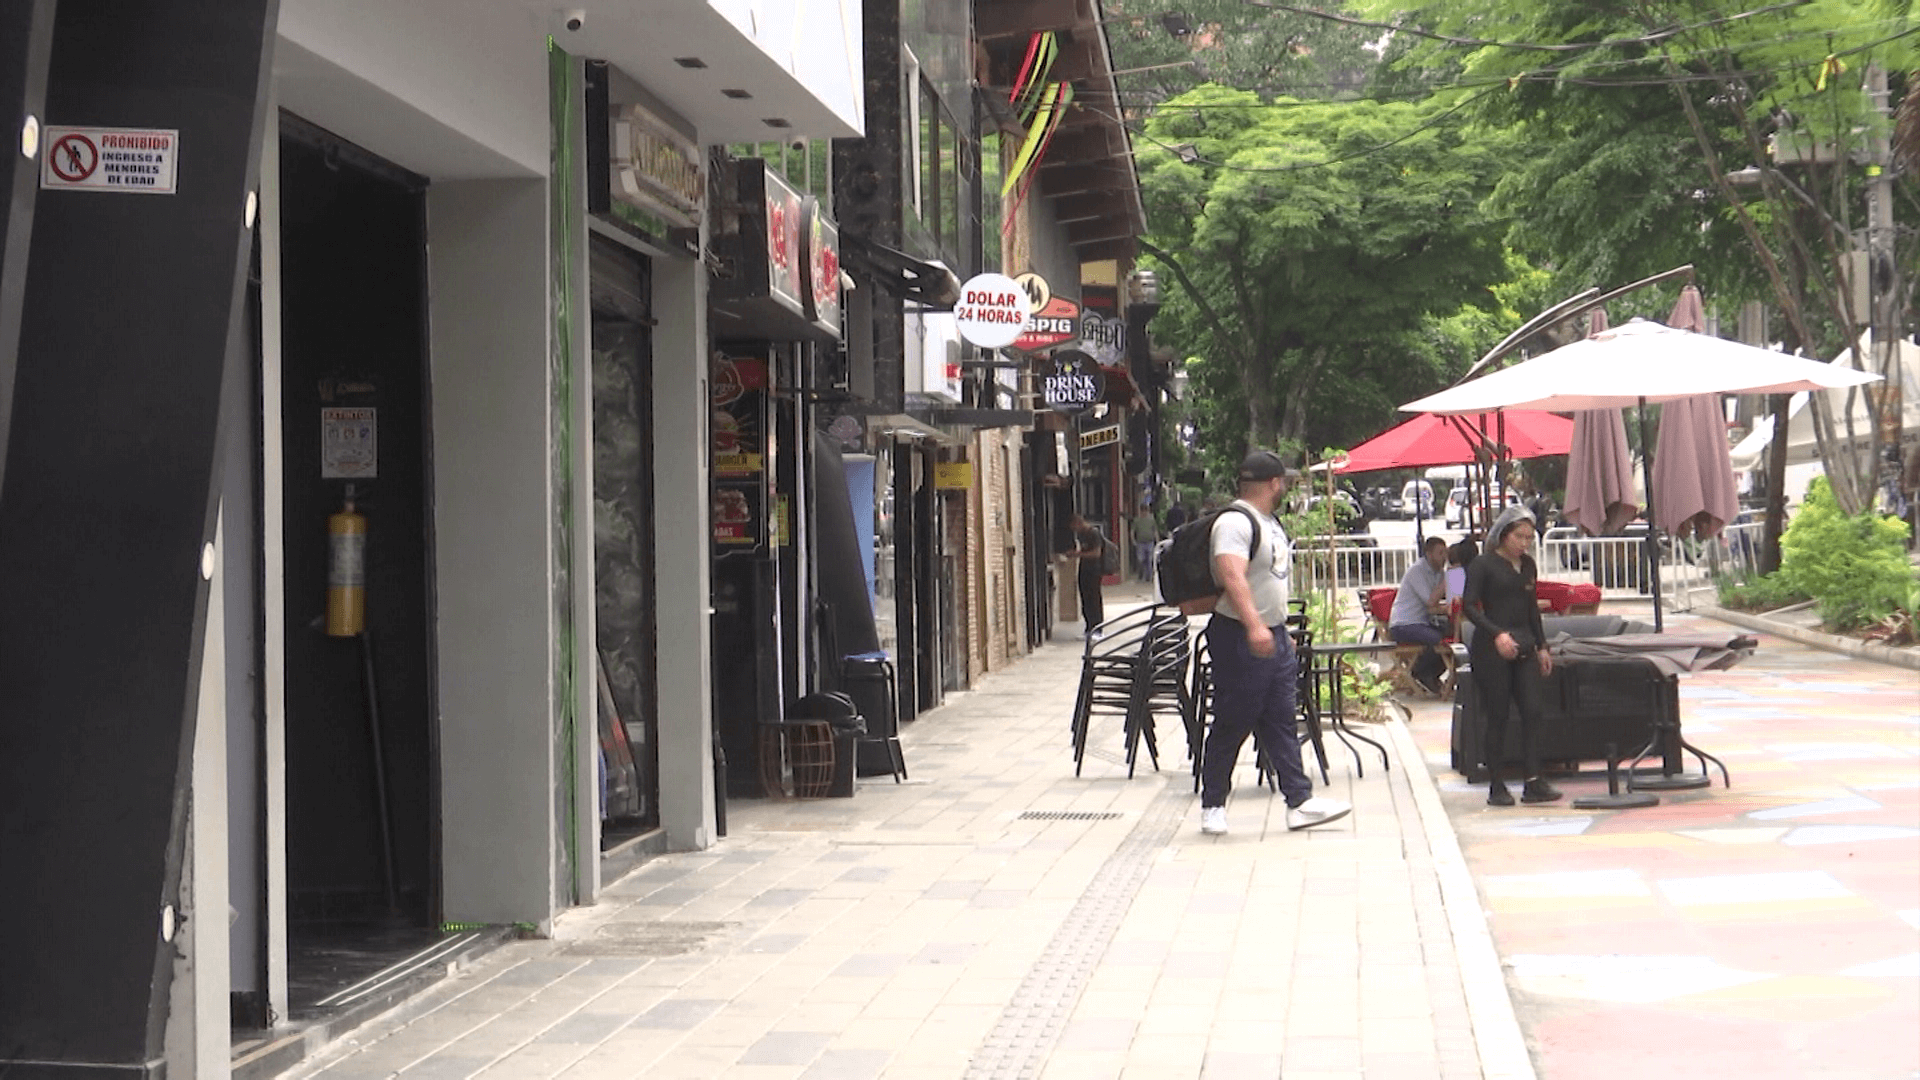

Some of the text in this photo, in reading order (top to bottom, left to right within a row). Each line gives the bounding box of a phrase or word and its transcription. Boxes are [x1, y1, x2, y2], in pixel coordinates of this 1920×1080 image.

[102, 134, 169, 149] PROHIBIDO
[102, 152, 163, 163] INGRESO A
[104, 163, 160, 174] MENORES
[107, 175, 156, 185] DE EDAD
[966, 291, 1016, 307] DOLAR
[958, 307, 1022, 325] 24 HORAS
[1045, 374, 1095, 390] DRINK
[1045, 389, 1097, 403] HOUSE
